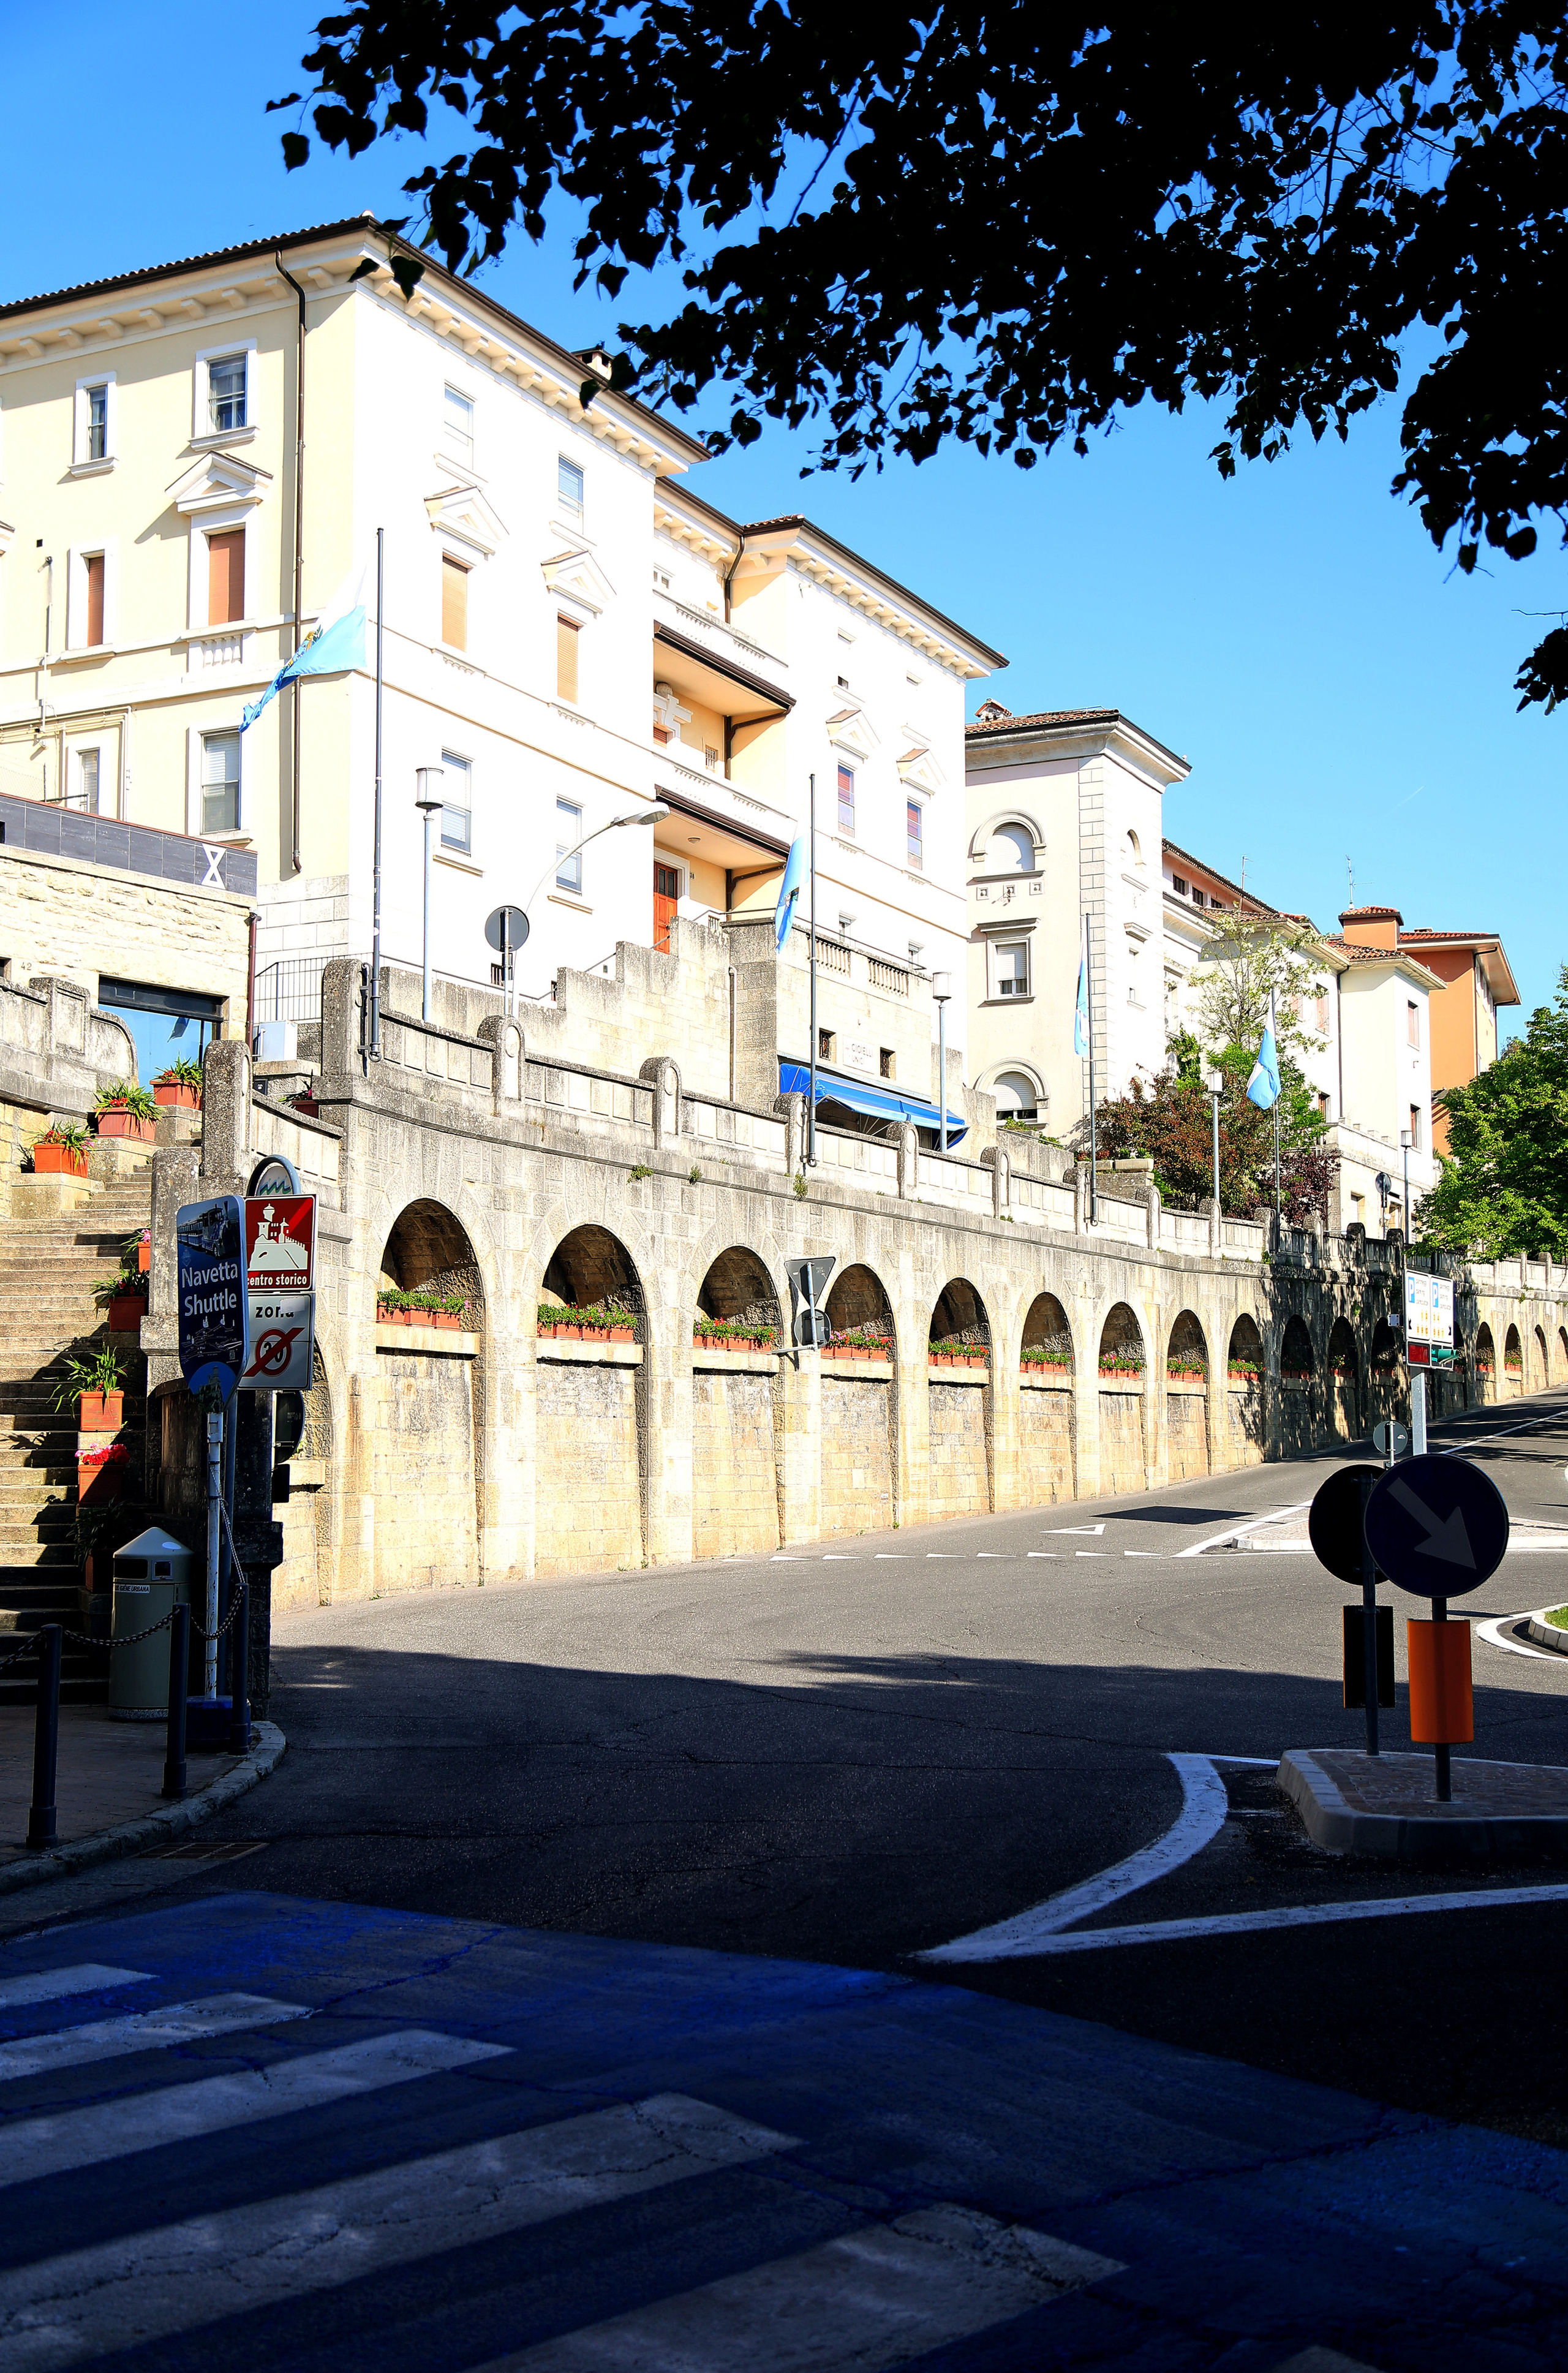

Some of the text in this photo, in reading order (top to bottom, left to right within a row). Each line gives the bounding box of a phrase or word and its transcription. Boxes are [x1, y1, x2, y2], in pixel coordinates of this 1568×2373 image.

[21, 962, 32, 971] 42
[851, 1043, 873, 1058] GIOIELLI
[182, 1261, 238, 1288] Navetta
[276, 1273, 307, 1285] storico
[184, 1288, 237, 1316] Shuttle
